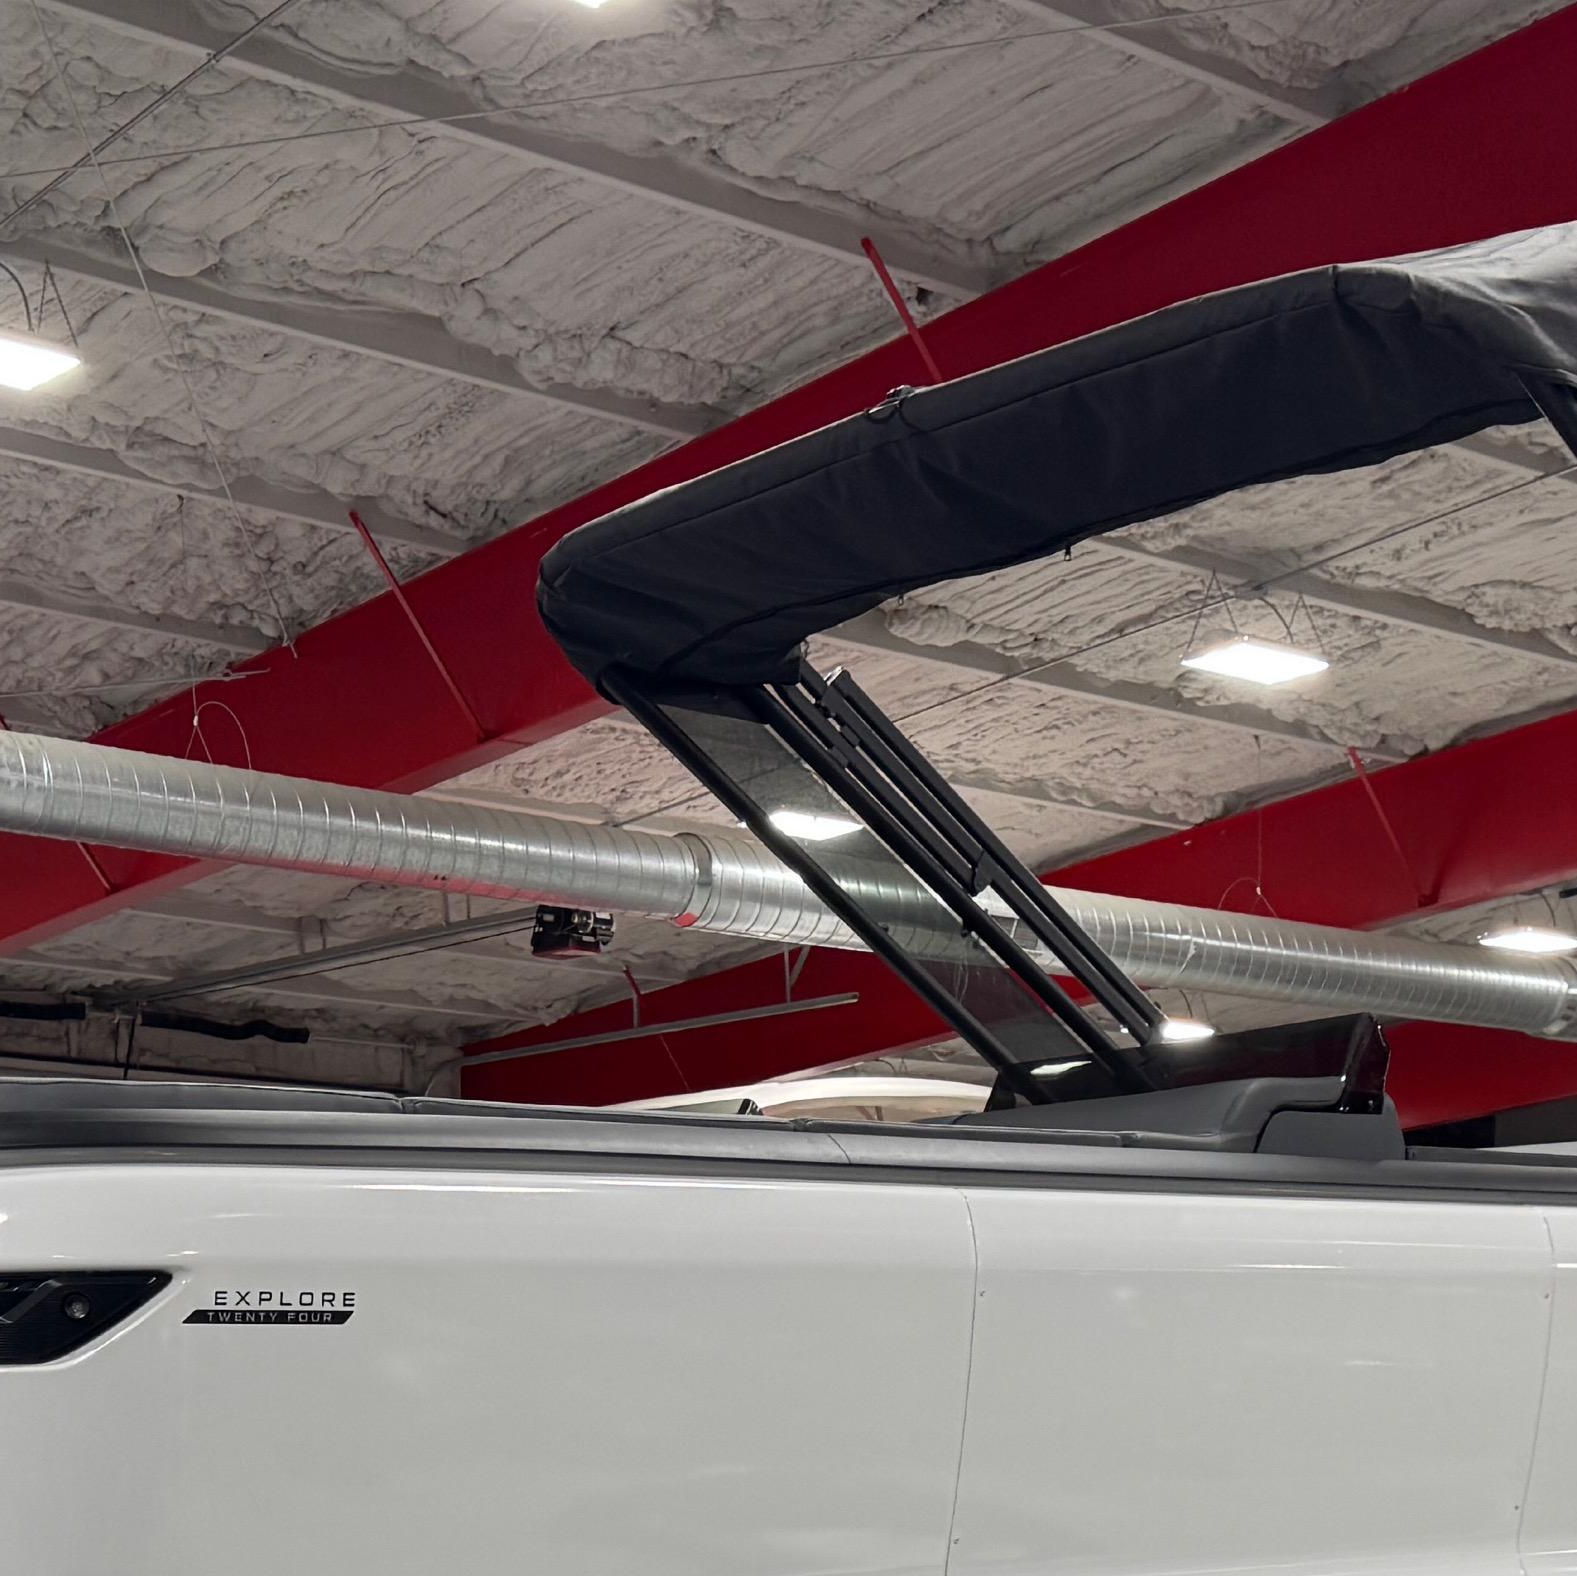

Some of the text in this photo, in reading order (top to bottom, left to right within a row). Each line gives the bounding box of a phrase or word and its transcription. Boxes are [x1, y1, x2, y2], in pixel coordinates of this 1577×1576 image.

[214, 1291, 356, 1307] EXPLORE
[208, 1312, 333, 1322] TWENTY FOUR
